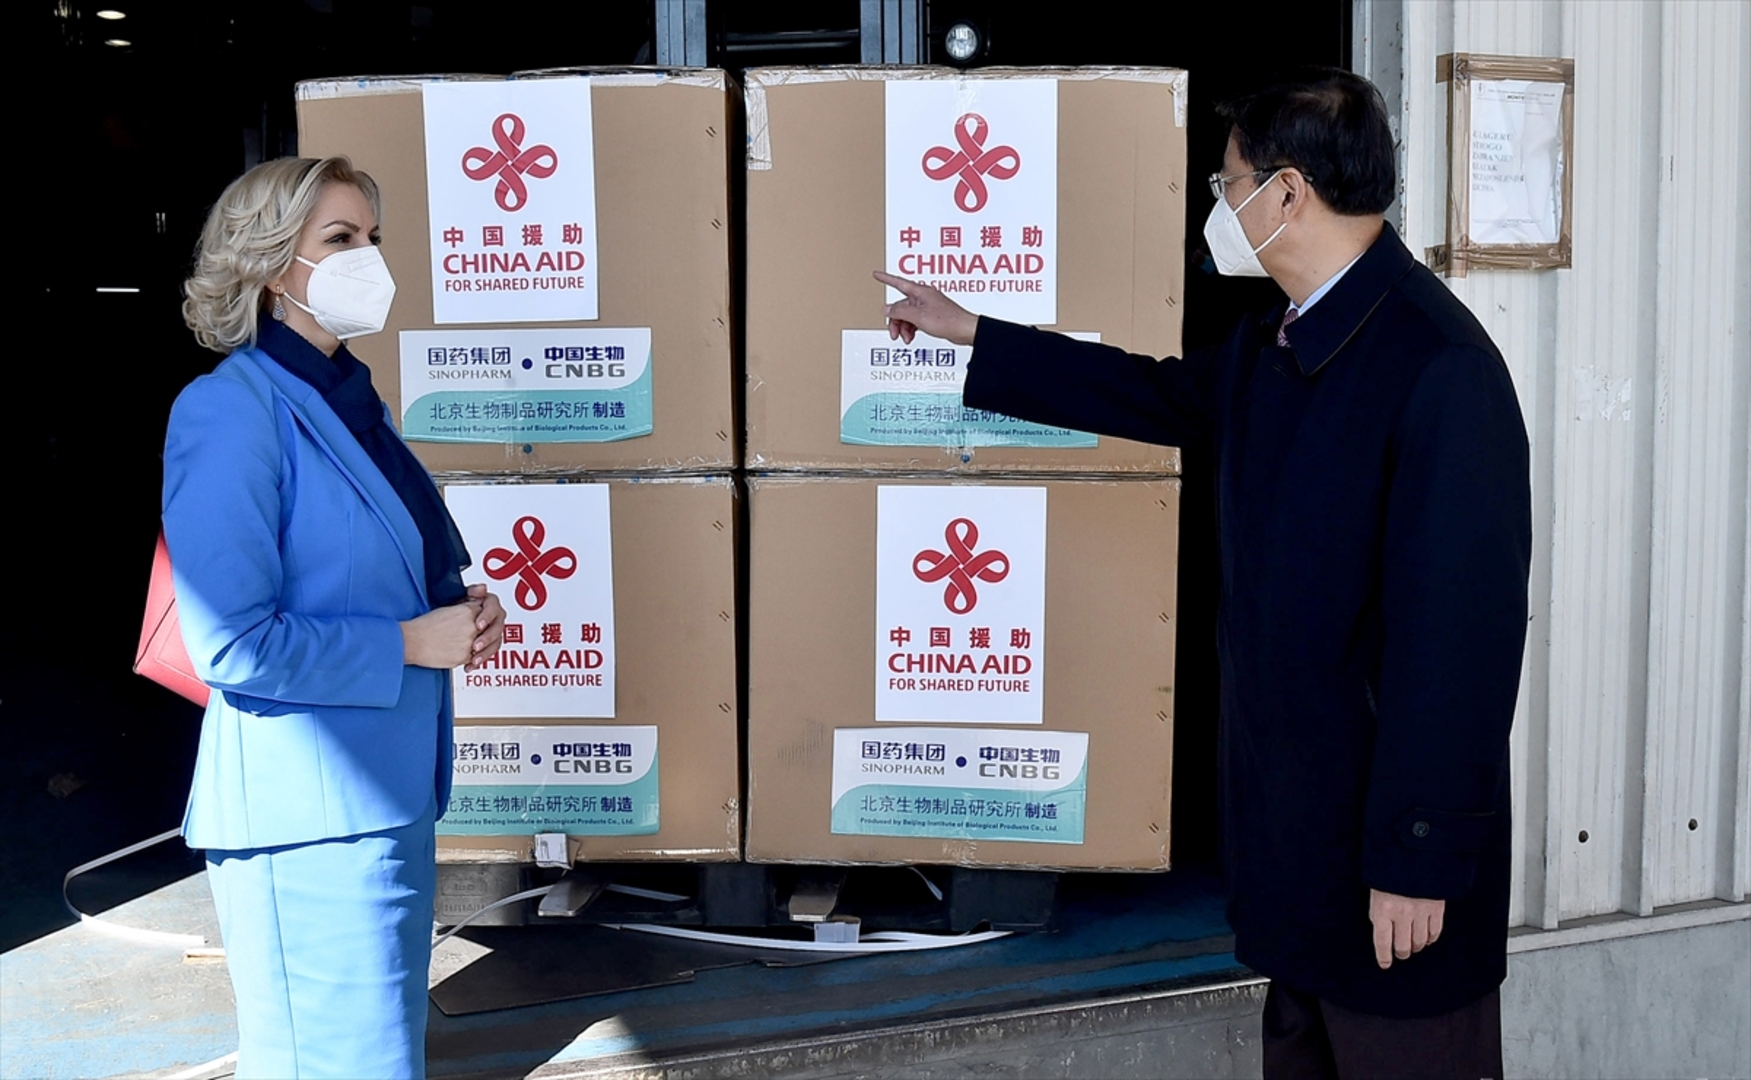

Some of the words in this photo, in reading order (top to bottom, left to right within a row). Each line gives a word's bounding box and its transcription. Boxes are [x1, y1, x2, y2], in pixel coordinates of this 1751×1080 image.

[443, 223, 583, 248] 中国援助
[900, 226, 1043, 248] 中国援助
[443, 252, 531, 275] CHINA
[536, 251, 585, 271] AID
[899, 254, 988, 275] CHINA
[993, 254, 1044, 274] AID
[445, 279, 472, 292] FOR
[475, 278, 529, 291] SHARED
[533, 277, 584, 290] FUTURE
[990, 280, 1043, 292] FUTURE
[428, 347, 511, 365] 国药集团
[545, 346, 625, 361] 中国生物
[871, 348, 955, 366] 国药集团
[429, 370, 511, 380] SINOPHARM
[546, 364, 625, 378] CNBG
[871, 370, 955, 381] SINOPHARM
[430, 402, 590, 419] 北京生物制品研究所
[593, 402, 625, 418] 制造
[430, 425, 461, 433] Produced
[534, 425, 567, 433] Biological
[1012, 428, 1043, 436] Products
[1059, 429, 1071, 437] Ltd.
[503, 623, 600, 644] 国援助
[890, 626, 1031, 649] 中国援助
[477, 650, 550, 669] HINA
[555, 650, 603, 669] AID
[888, 653, 976, 674] CHINA
[981, 654, 1032, 675] AID
[466, 674, 492, 687] FOR
[495, 674, 548, 687] SHARED
[553, 674, 602, 686] FUTURE
[889, 678, 916, 690] FOR
[919, 678, 974, 691] SHARED
[978, 679, 1030, 692] FUTURE
[453, 743, 520, 760] 药集团
[553, 743, 632, 758] 中国生物
[862, 741, 945, 762] 国药集团
[979, 746, 1060, 764] 中国生物
[453, 764, 521, 774] NOPHARM
[554, 760, 632, 773] CNBG
[861, 763, 945, 776] SINOPHARM
[979, 763, 1060, 780] CNBG
[601, 797, 633, 812] 制造
[860, 795, 1021, 819] 北京生物制品研究所
[1025, 802, 1058, 820] 制造
[483, 818, 506, 826] Beijing
[860, 817, 892, 826] Produced
[903, 819, 926, 827] Beijing
[965, 820, 999, 830] Biological
[1000, 822, 1029, 831] Products
